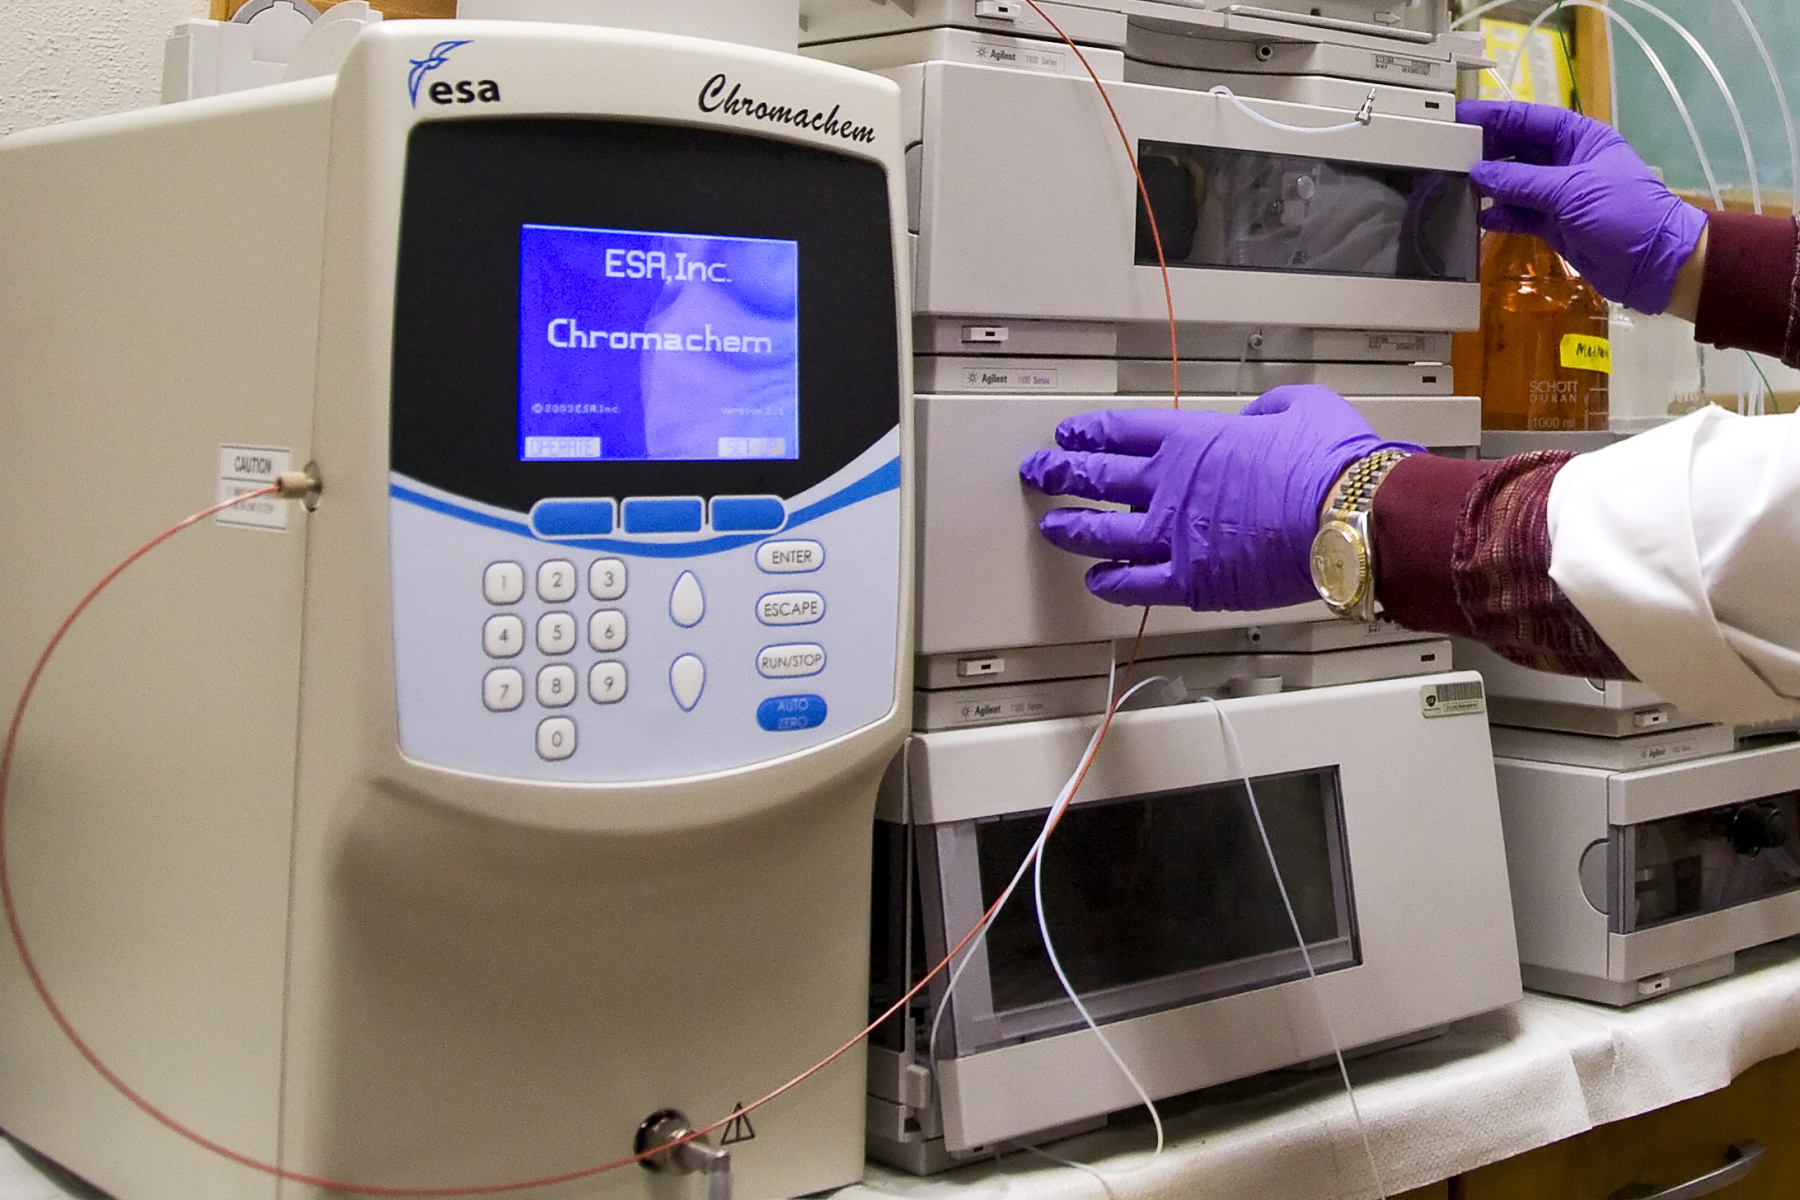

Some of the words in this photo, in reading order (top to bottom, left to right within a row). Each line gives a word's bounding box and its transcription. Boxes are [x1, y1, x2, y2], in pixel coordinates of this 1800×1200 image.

[990, 49, 1016, 61] Agilent
[428, 79, 500, 104] esa
[698, 74, 876, 144] Chromachem
[547, 318, 773, 353] Chromachem
[982, 373, 1007, 385] Agilent
[1529, 380, 1578, 393] SCHOTT
[1533, 416, 1560, 429] 1000
[772, 550, 812, 565] ENTER
[552, 572, 562, 588] 2
[604, 571, 614, 588] 3
[764, 601, 818, 617] ESCAPE
[499, 629, 509, 643] 4
[552, 624, 562, 641] 5
[604, 624, 615, 640] 6
[762, 653, 822, 669] RUN/STOP
[500, 684, 509, 700] 7
[551, 678, 562, 694] 8
[604, 676, 614, 691] 9
[777, 698, 810, 711] AUTO
[975, 705, 1001, 717] Agilent
[551, 731, 563, 747] 0
